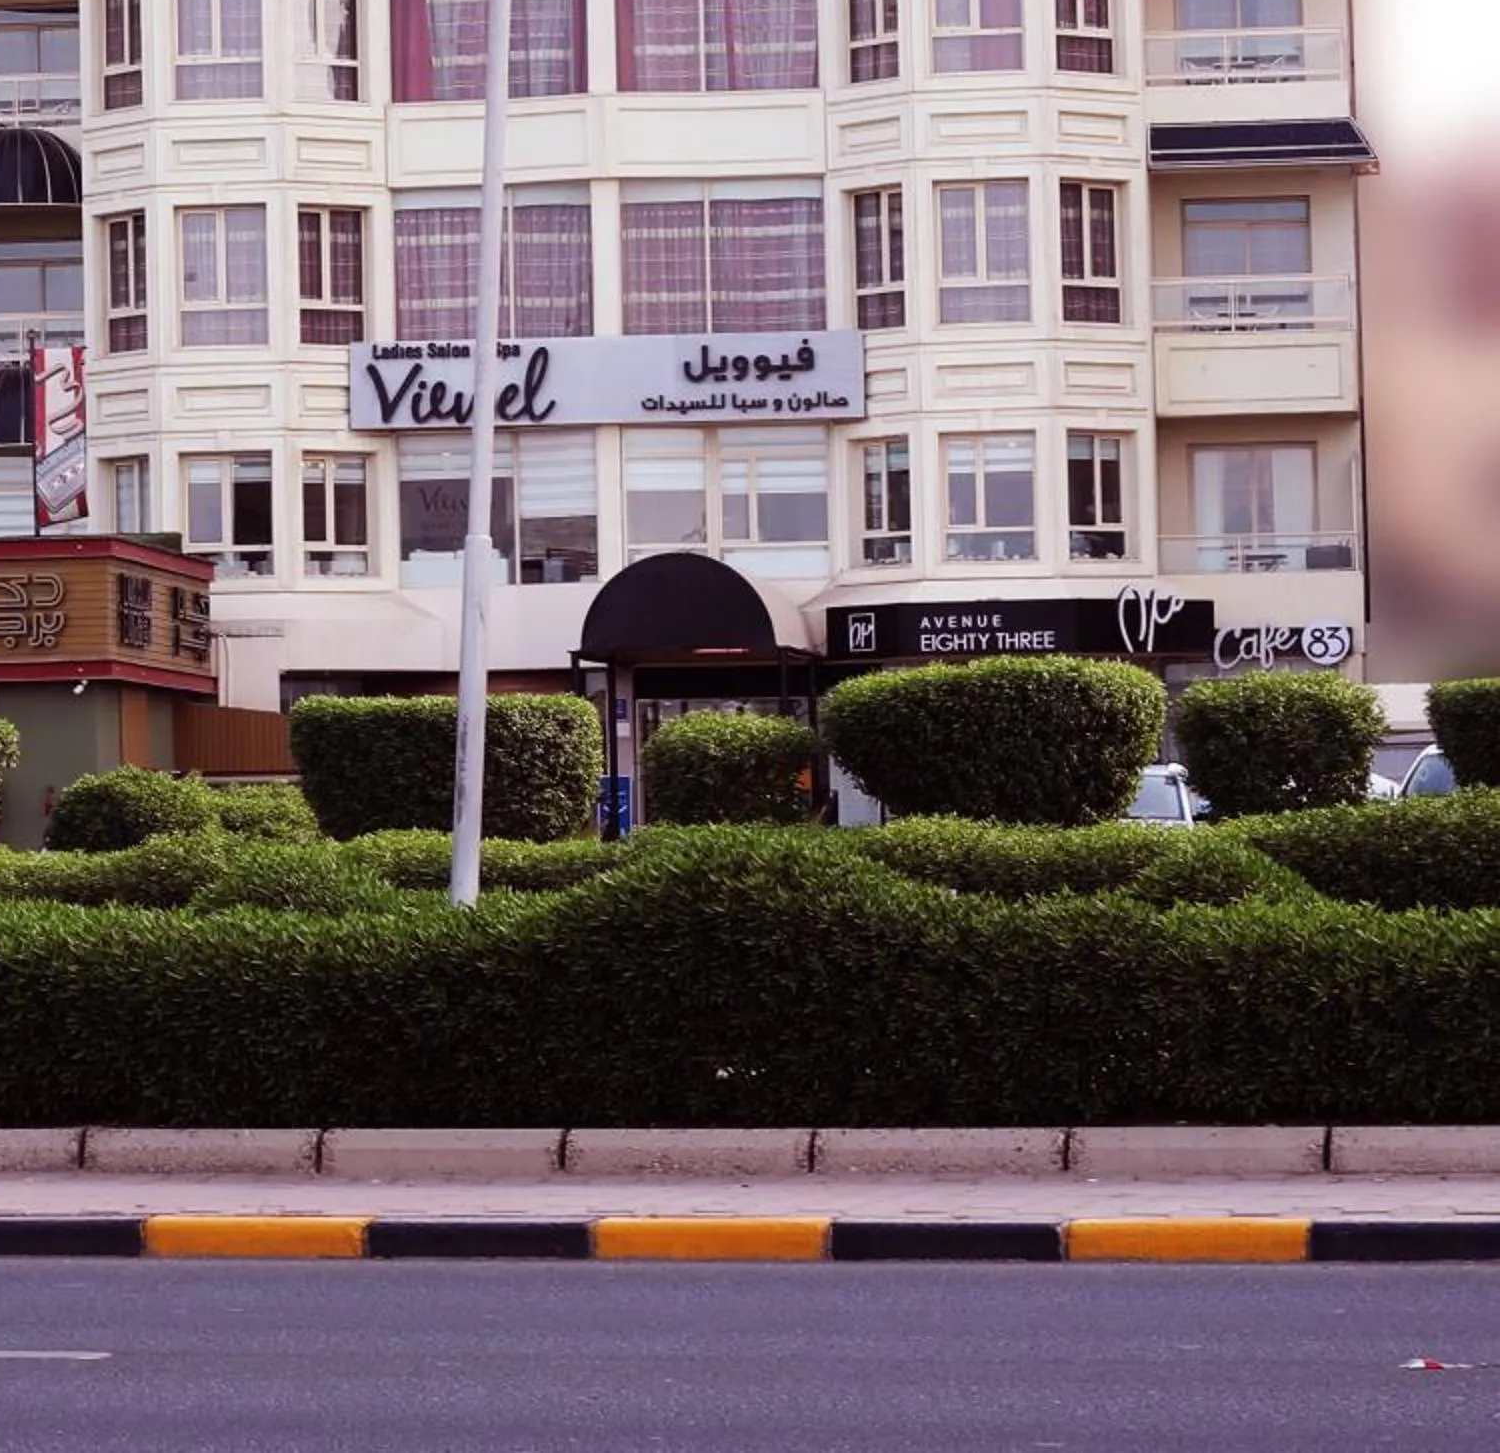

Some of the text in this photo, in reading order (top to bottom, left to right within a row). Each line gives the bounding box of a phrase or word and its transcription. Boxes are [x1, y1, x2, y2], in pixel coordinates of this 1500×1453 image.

[372, 344, 423, 359] Ladies
[428, 342, 471, 358] Salon
[683, 339, 816, 383] فيوويل
[641, 391, 850, 415] صالون و سبا للسيدات
[920, 614, 1003, 629] AVENUE
[920, 630, 1057, 652] EIGHTY THREE
[1213, 622, 1347, 670] Cafe 83
